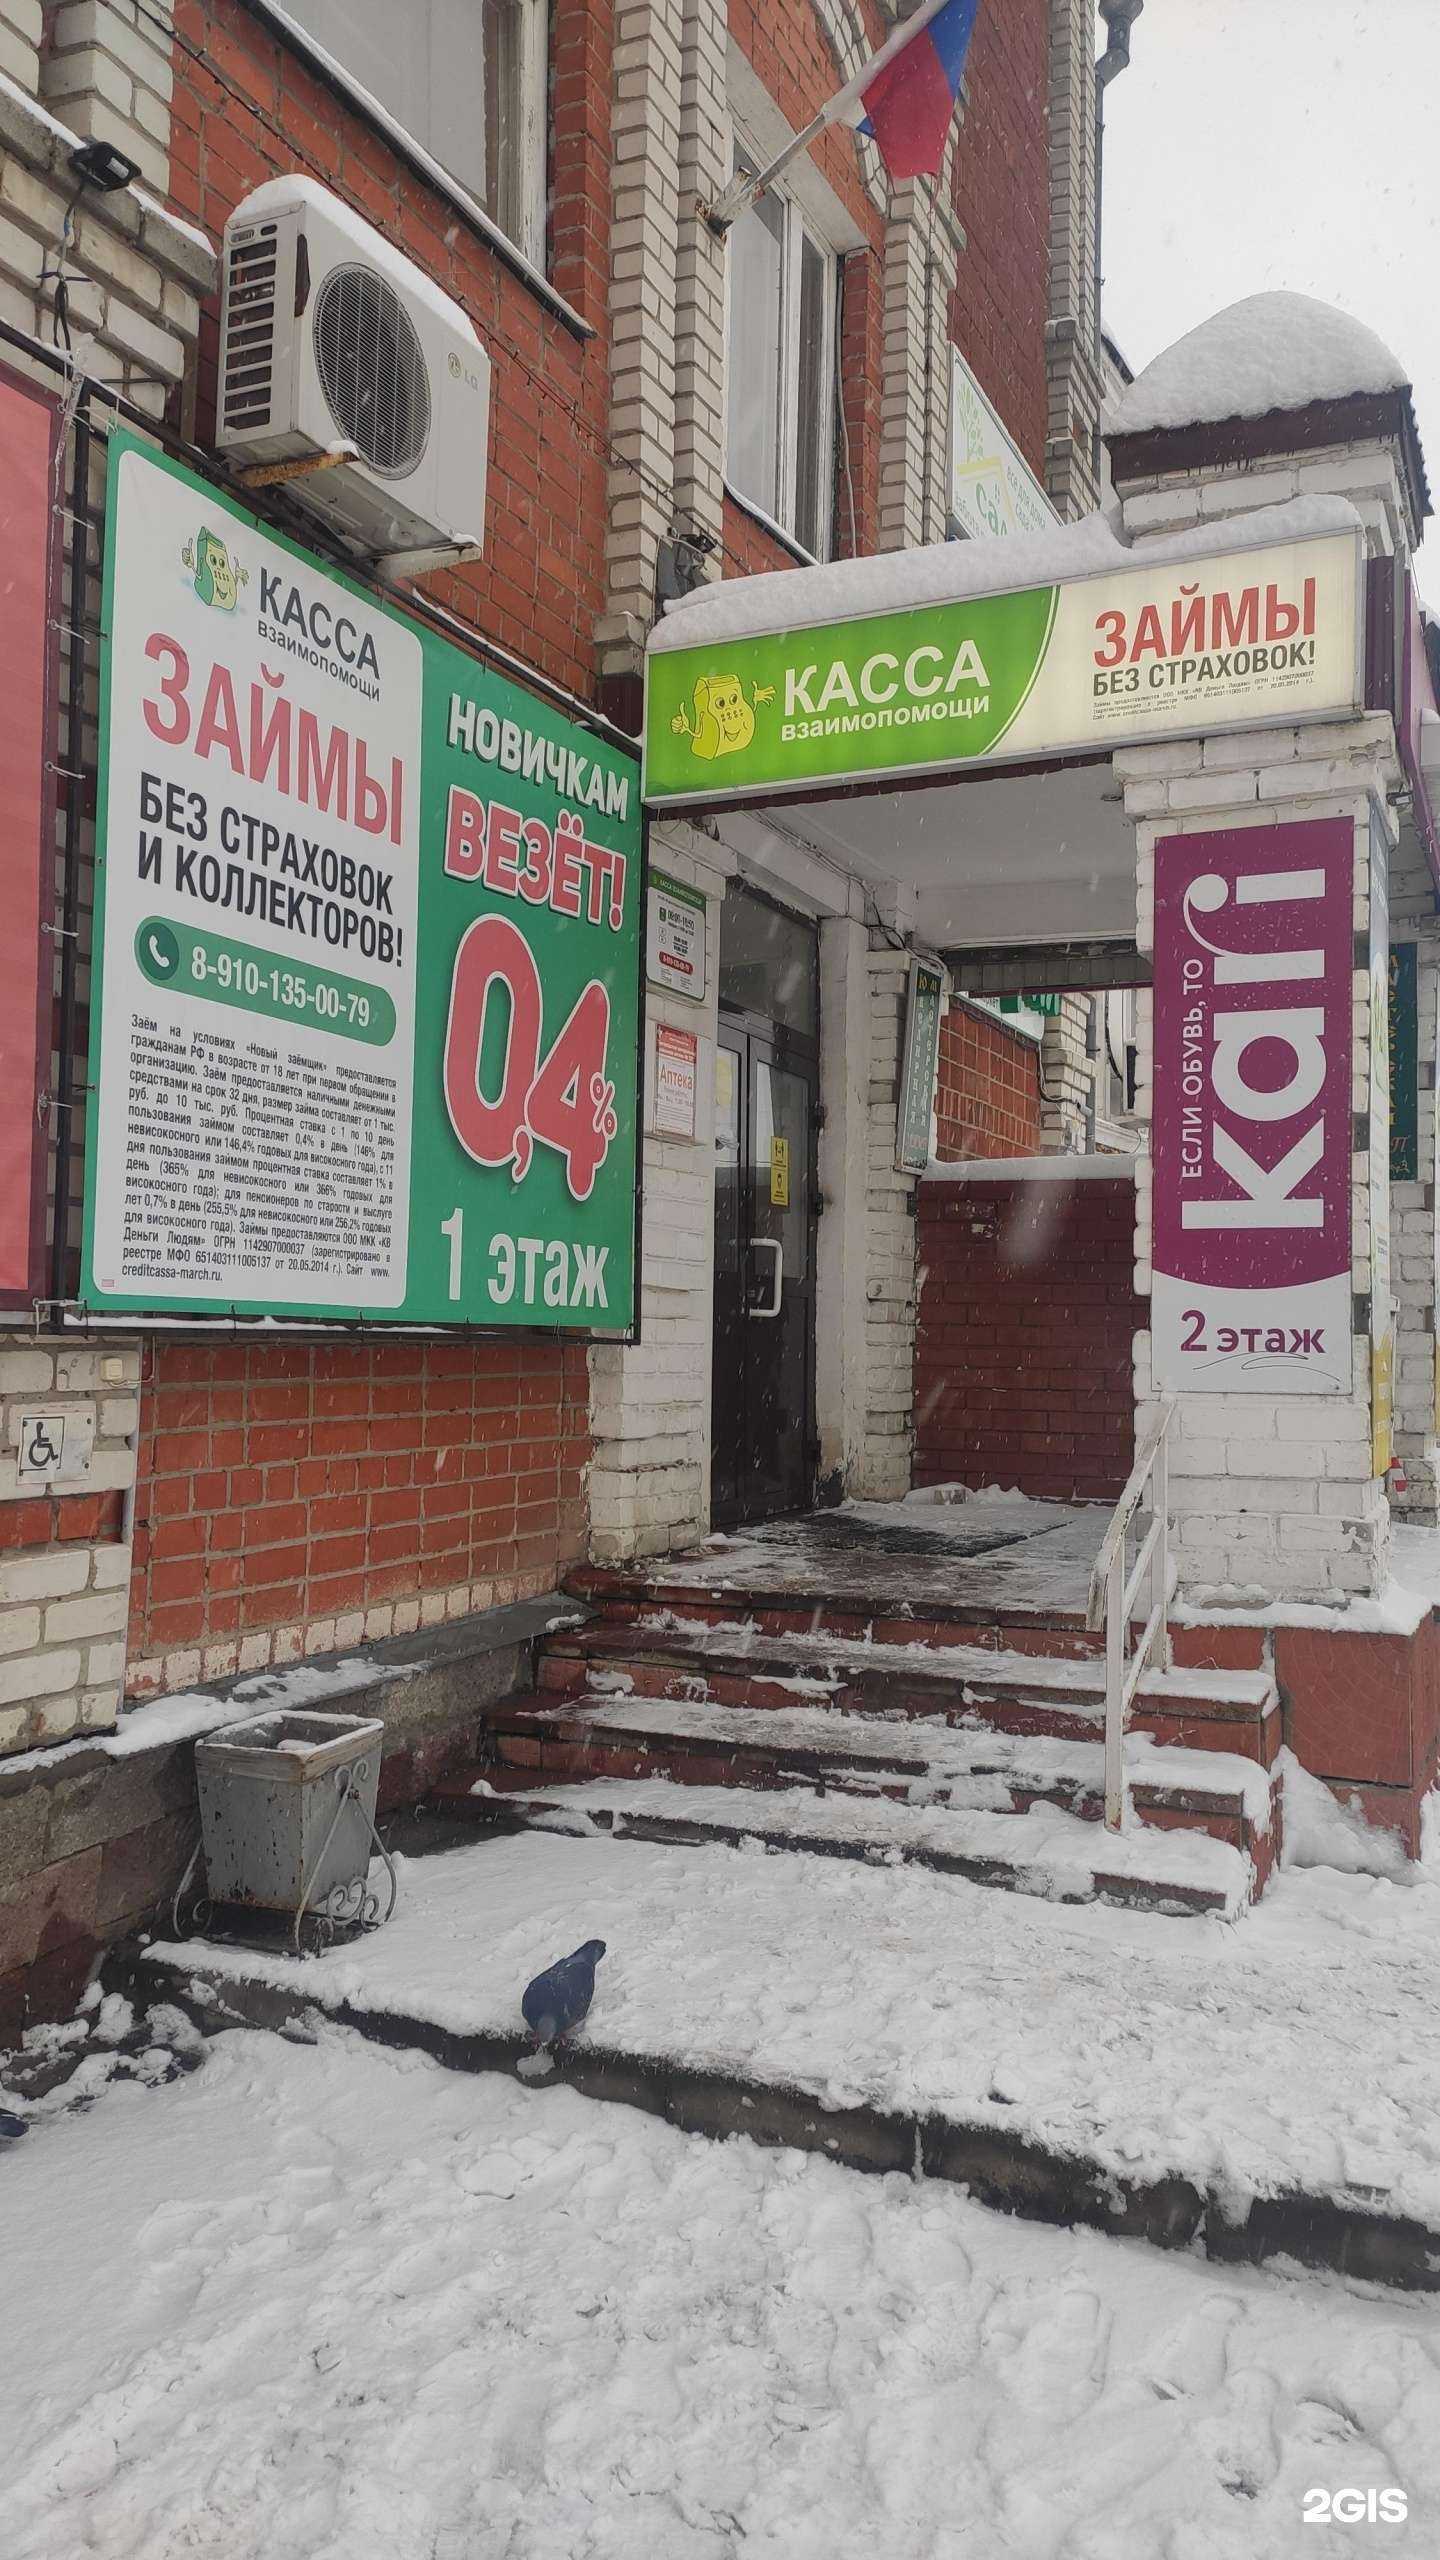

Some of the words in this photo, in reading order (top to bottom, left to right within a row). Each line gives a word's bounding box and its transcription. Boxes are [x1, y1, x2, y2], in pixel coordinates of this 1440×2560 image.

[260, 567, 380, 680] КАССА
[1093, 577, 1317, 668] ЗАЙМЫ
[257, 620, 380, 702] взаимопомощи
[782, 638, 991, 717] КАССА
[1092, 667, 1140, 697] БЕЗ
[1149, 640, 1317, 688] СТРАХОВОК!
[142, 632, 404, 847] ЗАЙМЫ
[780, 696, 991, 743] взаимопомощи
[448, 694, 629, 822] НОВИЧКАМ
[140, 771, 208, 842] БЕЗ
[220, 805, 393, 915] СТРАХОВОК
[444, 784, 628, 934] ВЕЗЁТ!
[137, 830, 162, 885] И
[175, 847, 404, 967] КОЛЛЕКТОРОВ!
[191, 945, 370, 1028] 8-910-135-00-79
[1182, 958, 1204, 996] ТО
[130, 1013, 157, 1032] Заём
[169, 1025, 181, 1037] на
[192, 1031, 235, 1050] условиях
[443, 913, 618, 1201] 0,4%
[1181, 868, 1327, 1230] kari
[1182, 1001, 1206, 1100] ОБУВЬ,
[129, 1051, 197, 1075] организацию.
[202, 1064, 226, 1081] Заём
[230, 1073, 302, 1098] предоставляется
[306, 1089, 349, 1108] наличными
[130, 1034, 186, 1056] гражданам
[190, 1044, 205, 1060] РФ
[208, 1051, 214, 1062] в
[217, 1053, 257, 1072] возрасте
[260, 1063, 270, 1074] от
[285, 1069, 300, 1081] лет
[301, 1072, 316, 1086] при
[319, 1076, 347, 1092] первом
[660, 1063, 693, 1090] Аптека
[128, 1086, 149, 1101] руб.
[155, 1092, 168, 1105] до
[193, 1099, 214, 1112] тыс.
[220, 1103, 238, 1118] руб.
[244, 1106, 294, 1128] Процентная
[299, 1119, 326, 1133] ставка
[129, 1069, 188, 1090] средствами
[190, 1081, 202, 1093] на
[204, 1084, 226, 1098] срок
[262, 1096, 292, 1114] размер
[294, 1102, 319, 1117] займа
[320, 1108, 362, 1125] составляет
[127, 1104, 191, 1125] пользования
[198, 1117, 235, 1133] займом
[241, 1124, 289, 1142] составляет
[319, 1139, 325, 1149] в
[330, 1141, 348, 1153] день
[127, 1122, 200, 1144] невисокосного
[204, 1135, 222, 1147] или
[256, 1144, 292, 1159] годовых
[292, 1149, 308, 1162] для
[310, 1152, 356, 1170] високосного
[1181, 1109, 1203, 1179] ЕСЛИ
[125, 1158, 149, 1171] день
[197, 1167, 215, 1180] для
[223, 1171, 286, 1190] невисокосного
[294, 1181, 309, 1192] или
[126, 1140, 145, 1153] дня
[148, 1143, 211, 1162] пользования
[214, 1153, 249, 1168] займом
[252, 1159, 300, 1176] процентная
[303, 1167, 329, 1180] ставка
[124, 1193, 142, 1205] лет
[169, 1198, 176, 1209] в
[177, 1199, 201, 1212] день
[238, 1206, 256, 1219] для
[257, 1208, 318, 1225] невисокосного
[318, 1216, 333, 1227] или
[361, 1221, 391, 1234] годовых
[125, 1175, 187, 1193] високосного
[223, 1188, 241, 1201] для
[245, 1191, 299, 1209] пенсионеров
[303, 1198, 313, 1209] по
[317, 1200, 350, 1214] старости
[122, 1226, 158, 1242] Деньги
[213, 1235, 235, 1249] ОГРН
[311, 1244, 380, 1263] (зарегистрировано
[385, 1253, 390, 1262] в
[123, 1211, 142, 1224] для
[146, 1213, 206, 1230] високосного
[209, 1220, 235, 1235] года).
[238, 1221, 268, 1235] Займы
[270, 1226, 340, 1243] предоставляются
[342, 1232, 357, 1245] ООО
[359, 1234, 376, 1247] МКК
[121, 1263, 222, 1281] creditcassa-march.ru.
[122, 1246, 162, 1262] реестре
[166, 1248, 190, 1262] МФО
[274, 1259, 284, 1269] от
[345, 1262, 363, 1275] Сайт
[440, 1207, 463, 1301] 1
[487, 1233, 610, 1309] этаж
[1180, 1309, 1207, 1352] 2
[1216, 1326, 1327, 1354] этаж
